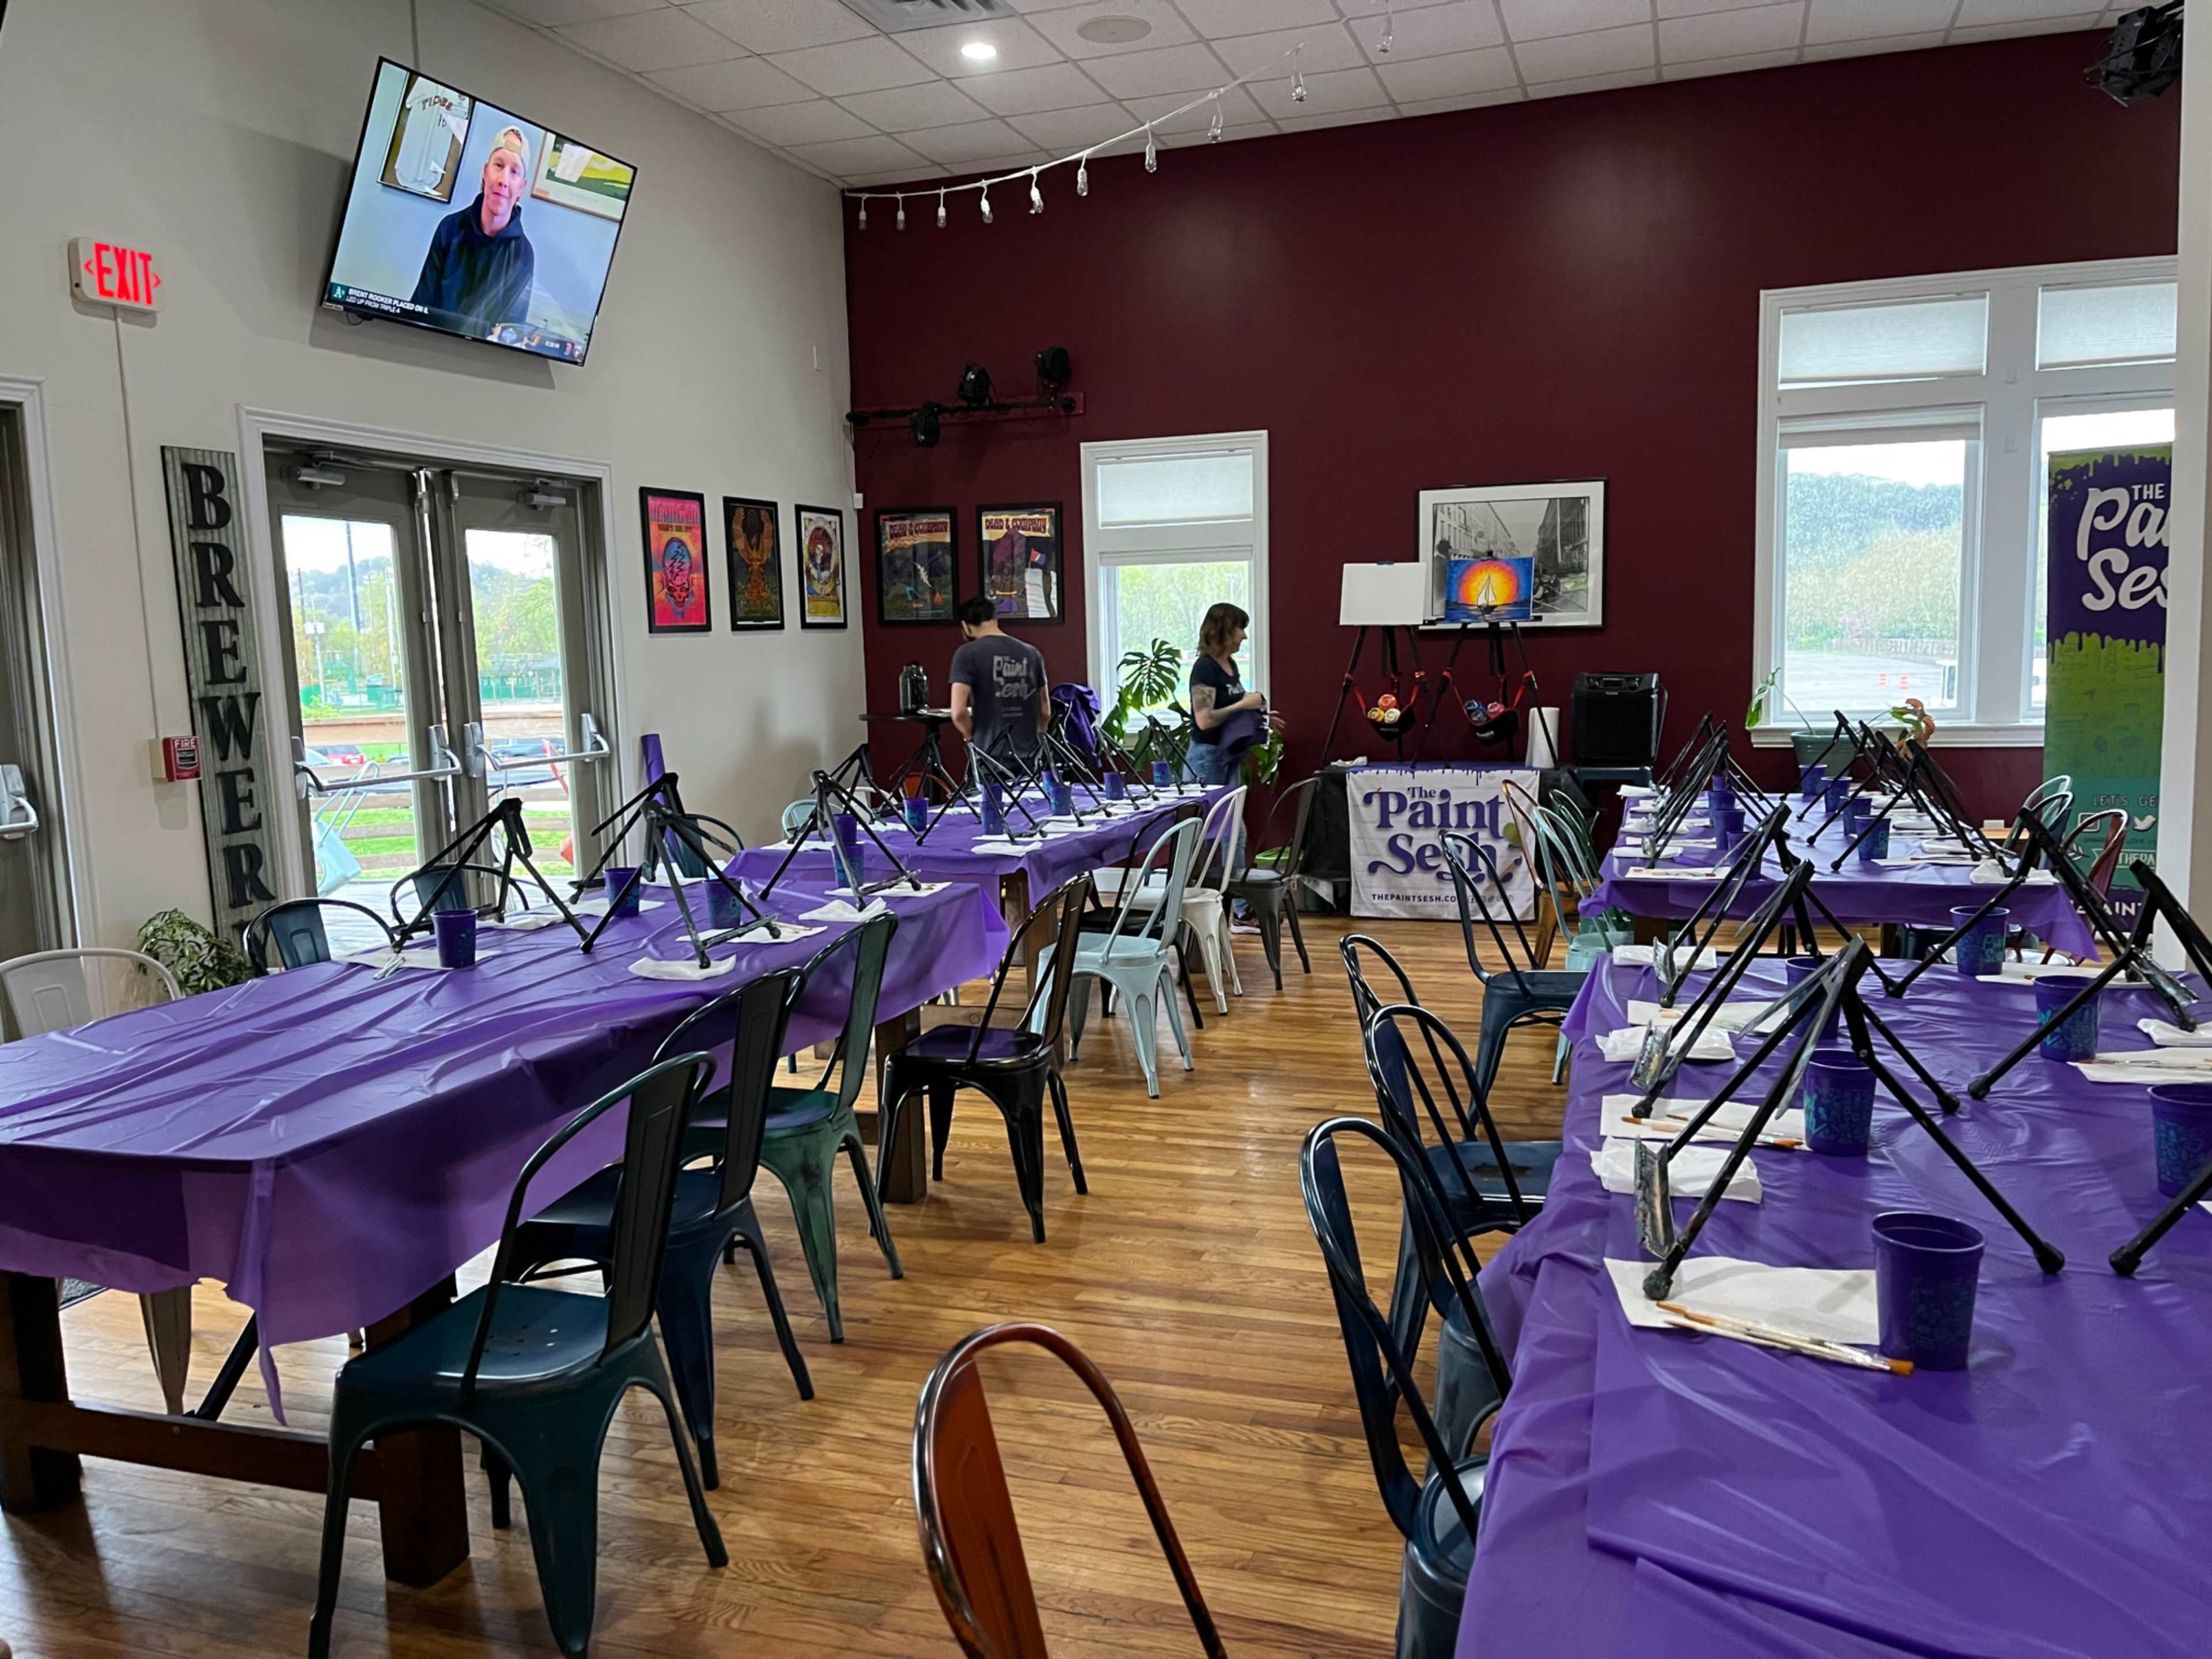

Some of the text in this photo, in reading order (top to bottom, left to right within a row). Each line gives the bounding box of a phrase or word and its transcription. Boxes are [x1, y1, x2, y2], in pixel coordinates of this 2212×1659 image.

[94, 242, 153, 306] EXIT
[349, 288, 369, 299] BRENT
[368, 293, 392, 305] ROOKER
[392, 299, 414, 310] PLACED
[415, 304, 423, 312] ON
[365, 300, 380, 309] FROM
[2132, 484, 2165, 501] THE
[175, 738, 196, 749] FIRE
[1408, 786, 1437, 799] The
[2138, 796, 2157, 807] GE
[1363, 789, 1505, 840] Paint
[2119, 853, 2156, 865] THEPA
[1372, 893, 1457, 903] THEPAINTSESH.CO
